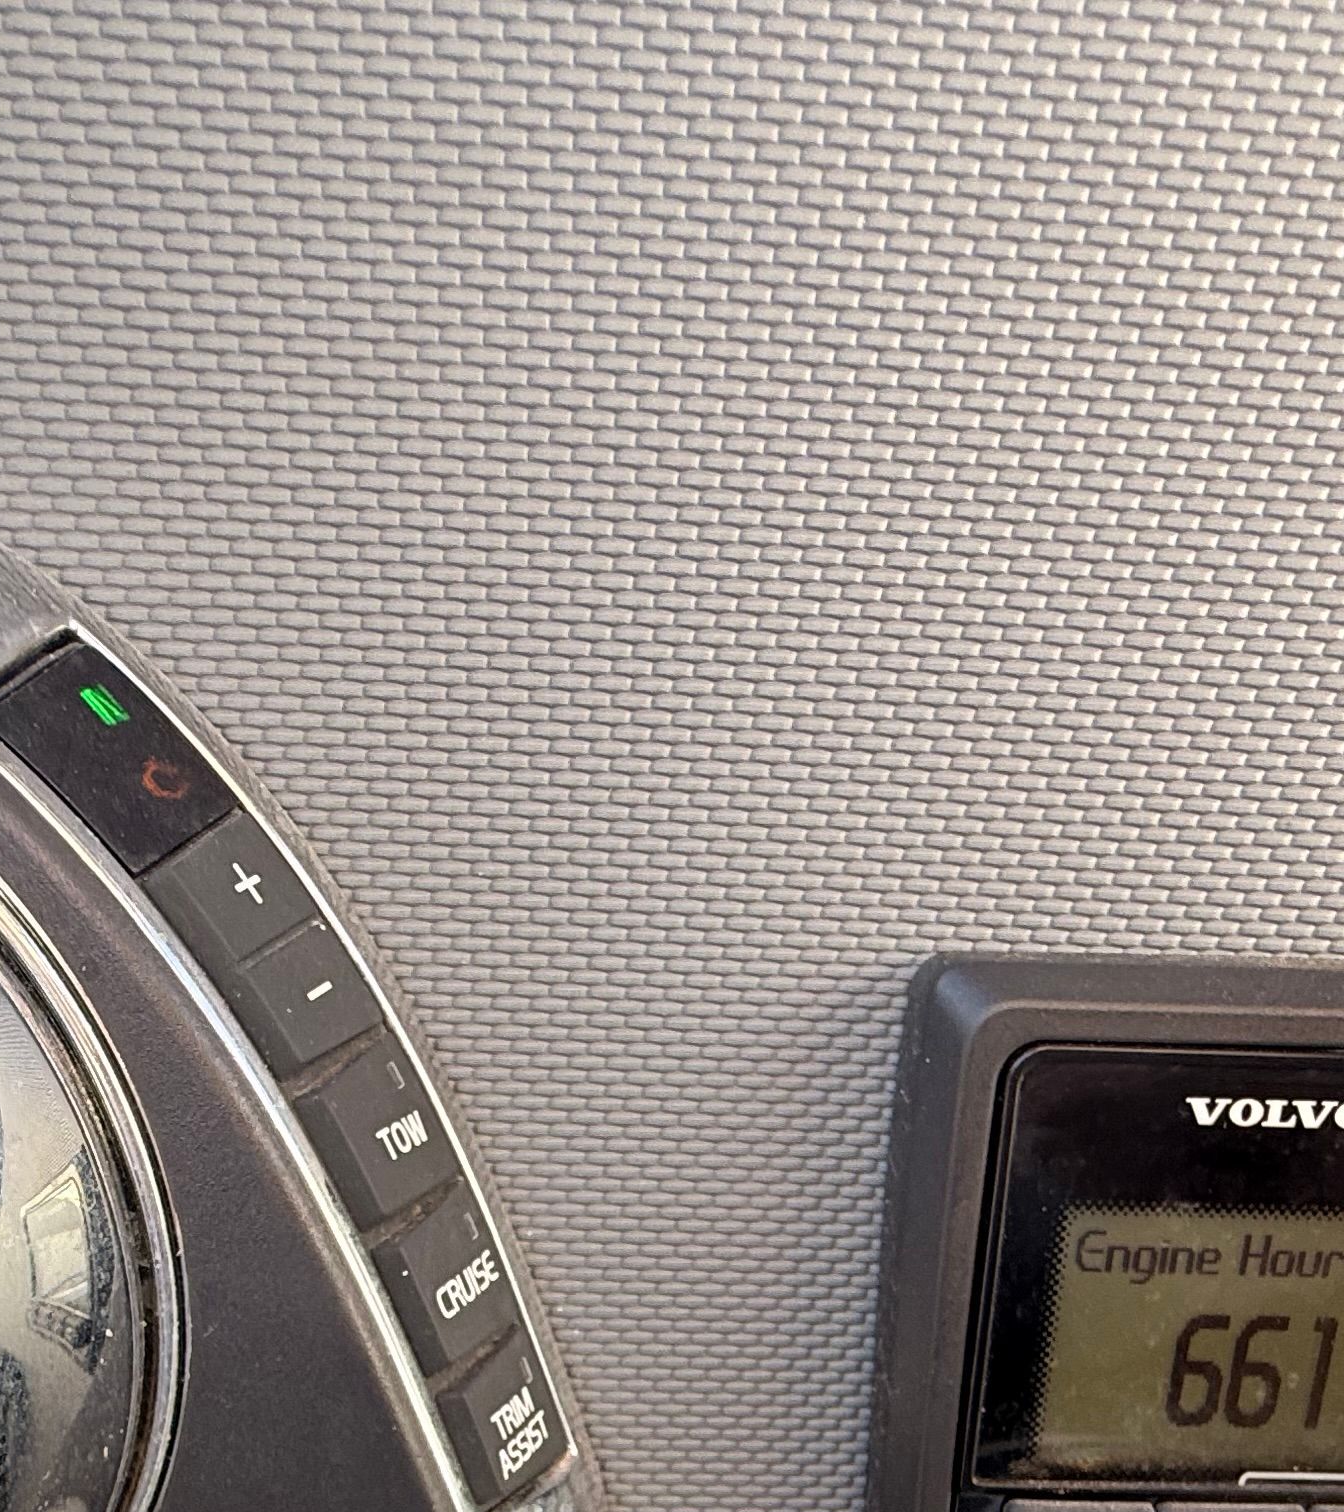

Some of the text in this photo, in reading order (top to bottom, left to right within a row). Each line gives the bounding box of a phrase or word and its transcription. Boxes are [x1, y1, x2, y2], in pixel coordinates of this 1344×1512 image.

[375, 1109, 429, 1161] TOW
[435, 1249, 500, 1321] CRUISE
[1074, 1230, 1224, 1285] Engine
[1164, 1313, 1339, 1430] 661
[489, 1385, 536, 1441] TRIM
[498, 1408, 549, 1481] ASSIST
